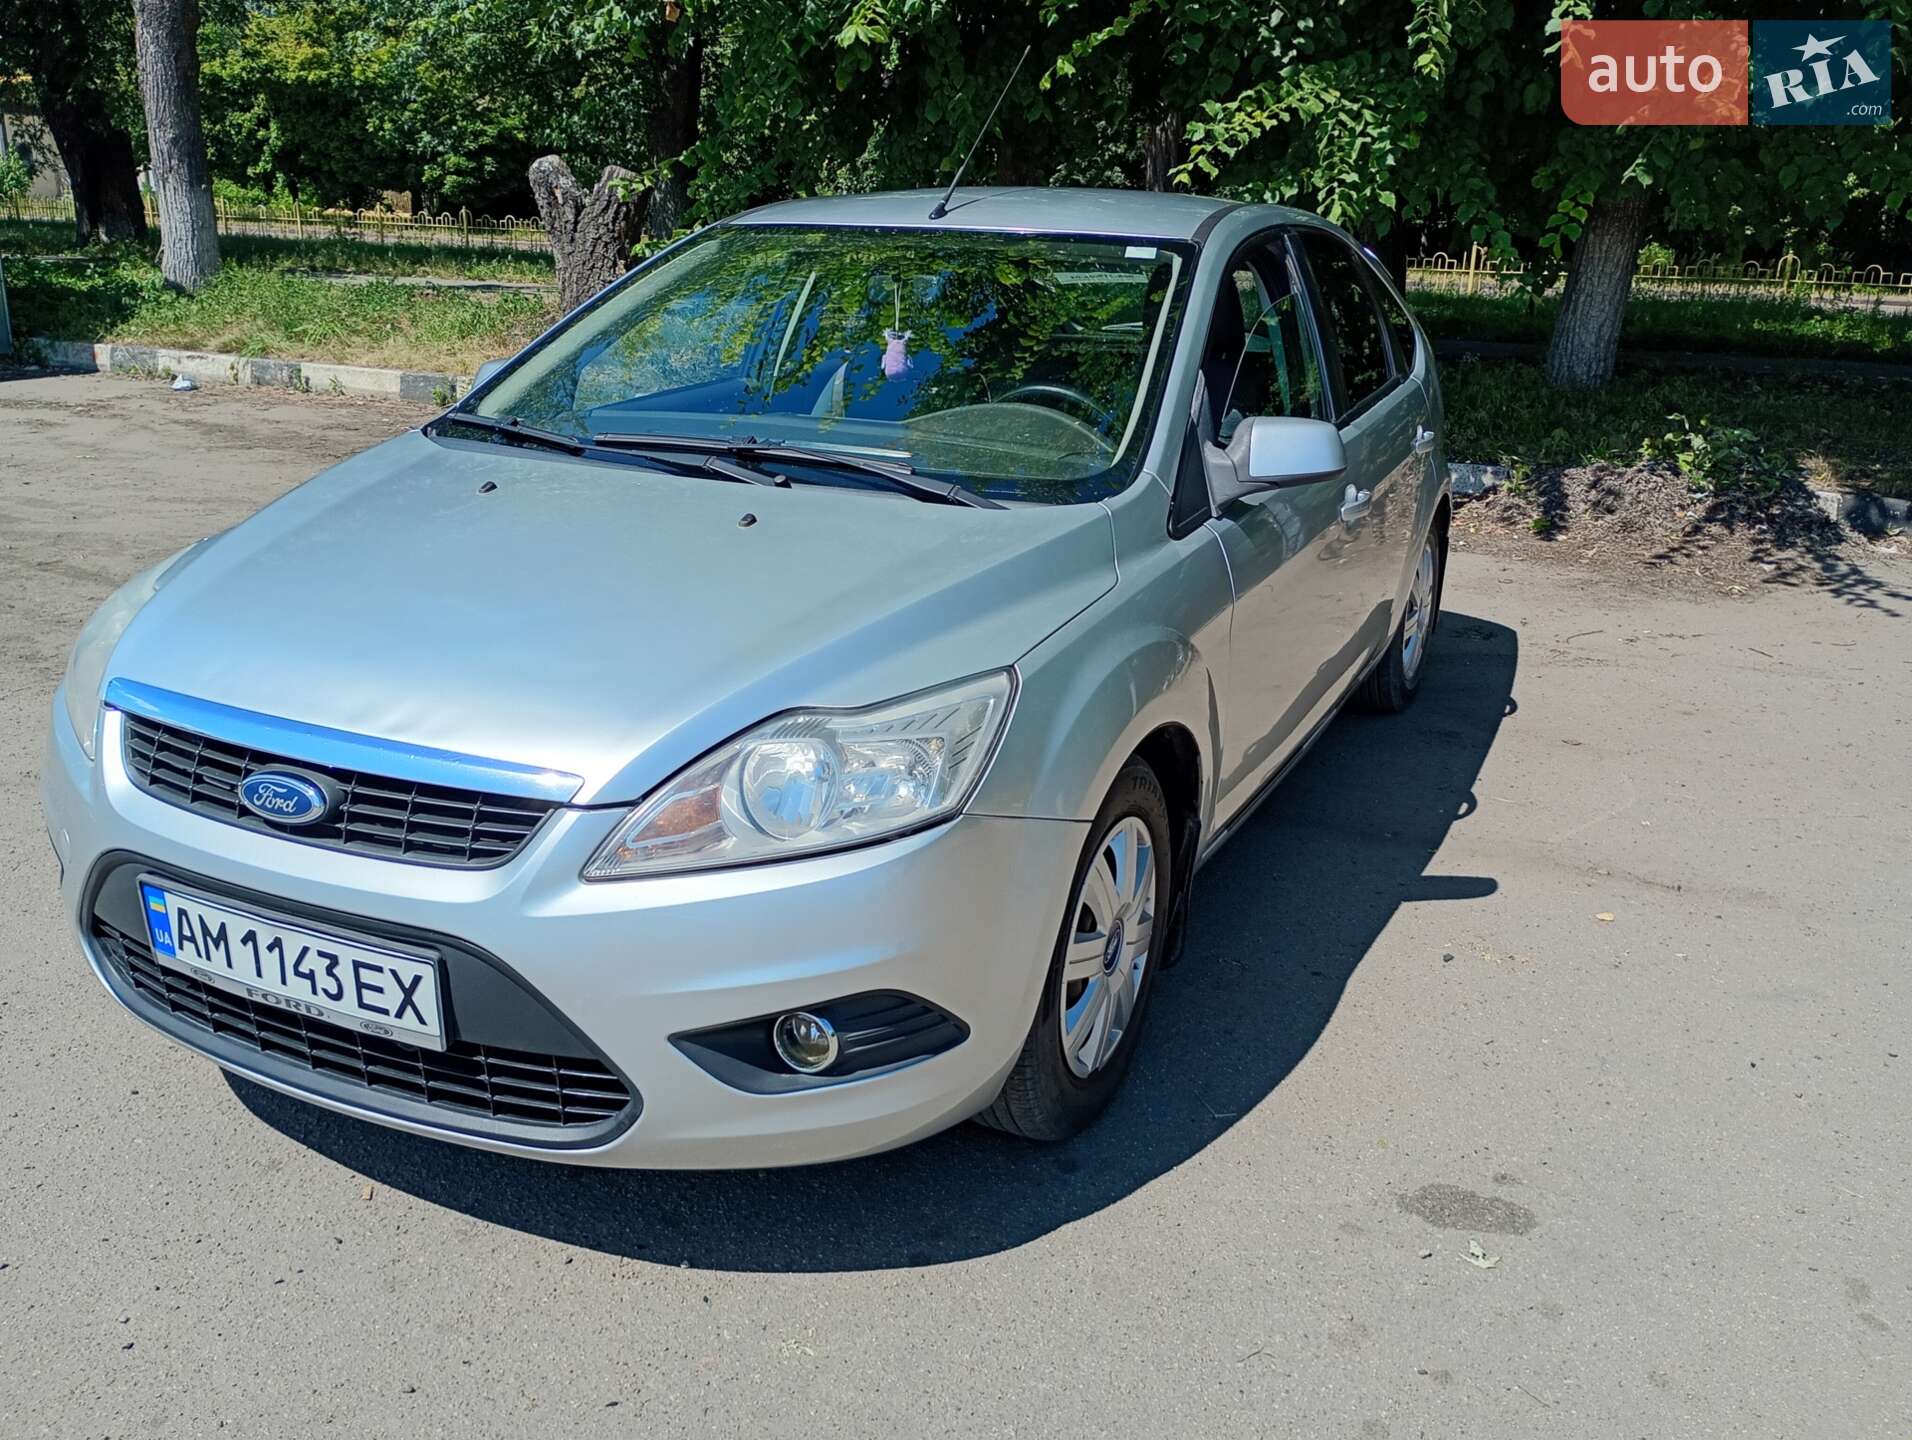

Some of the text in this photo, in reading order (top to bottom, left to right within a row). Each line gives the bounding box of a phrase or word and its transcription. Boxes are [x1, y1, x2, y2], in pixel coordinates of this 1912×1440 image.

[253, 783, 298, 813] Ford
[154, 927, 173, 947] UA
[245, 987, 325, 1018] FORD
